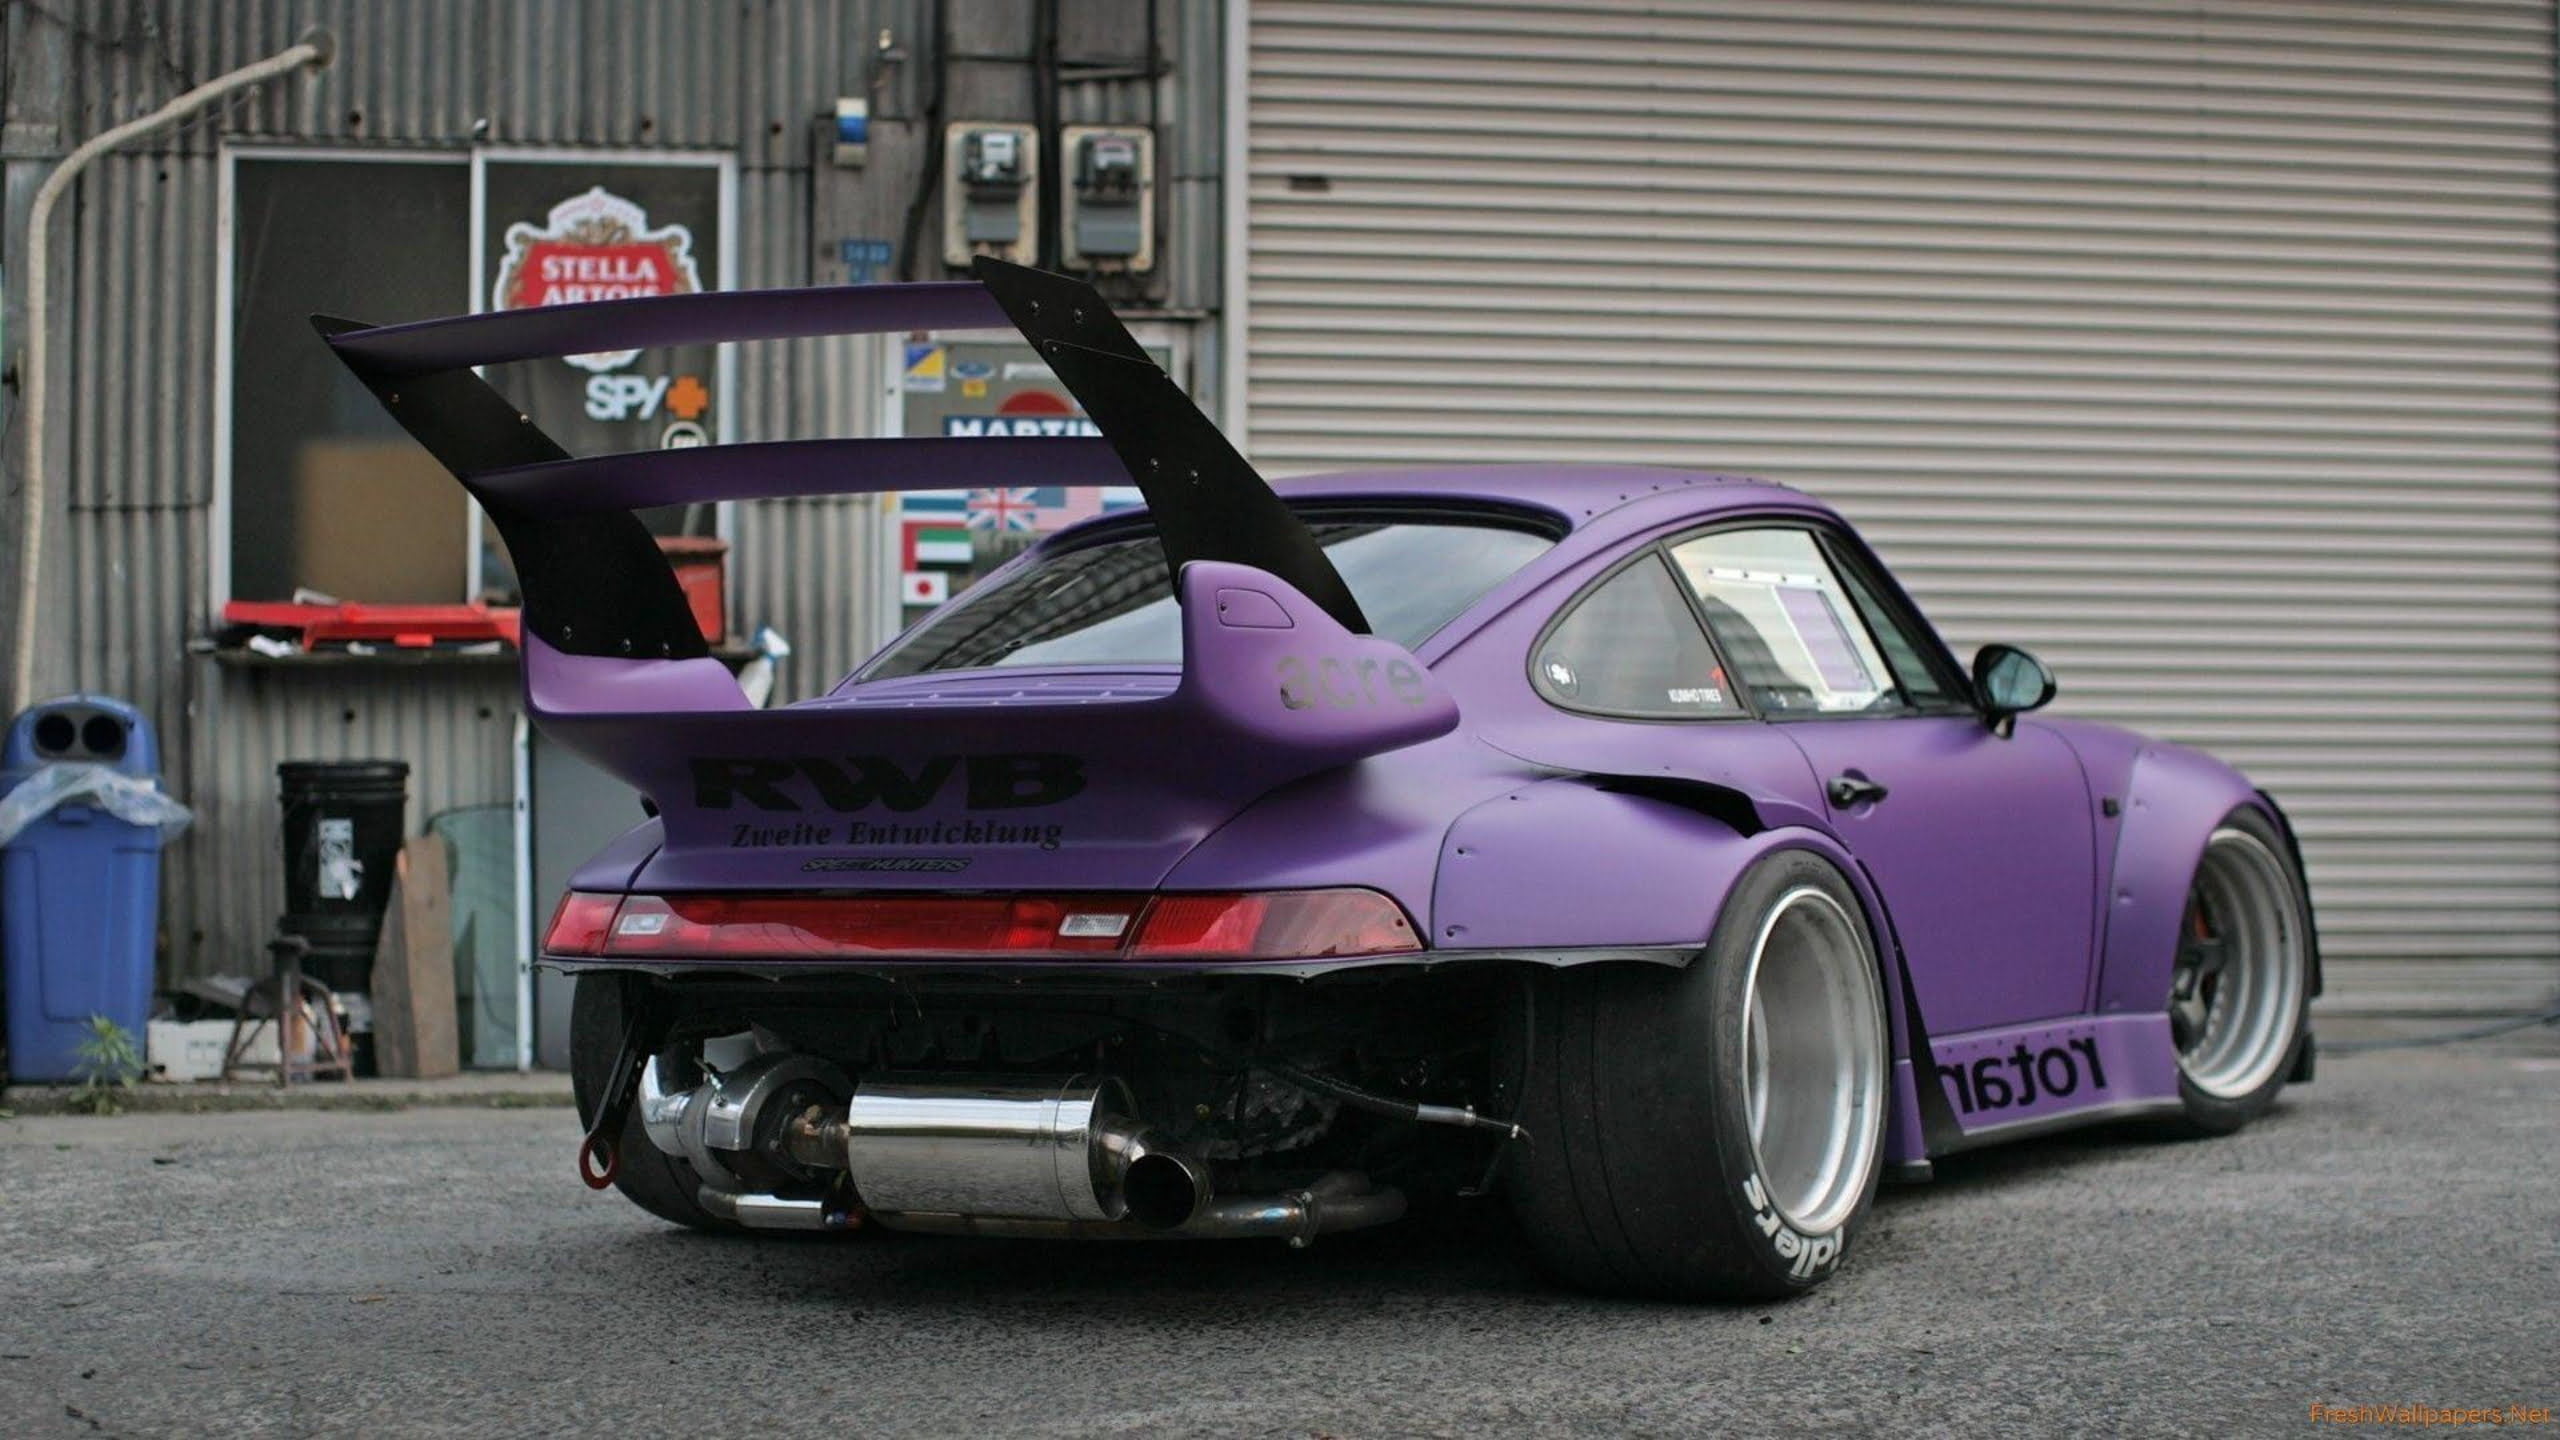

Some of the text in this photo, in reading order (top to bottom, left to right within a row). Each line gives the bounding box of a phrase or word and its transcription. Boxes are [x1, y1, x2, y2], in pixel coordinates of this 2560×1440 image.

[541, 254, 659, 283] STELLA
[584, 374, 670, 420] SPY
[1277, 655, 1427, 710] acre
[688, 753, 1088, 812] RWB
[731, 820, 1063, 850] Zweite Entwicklung
